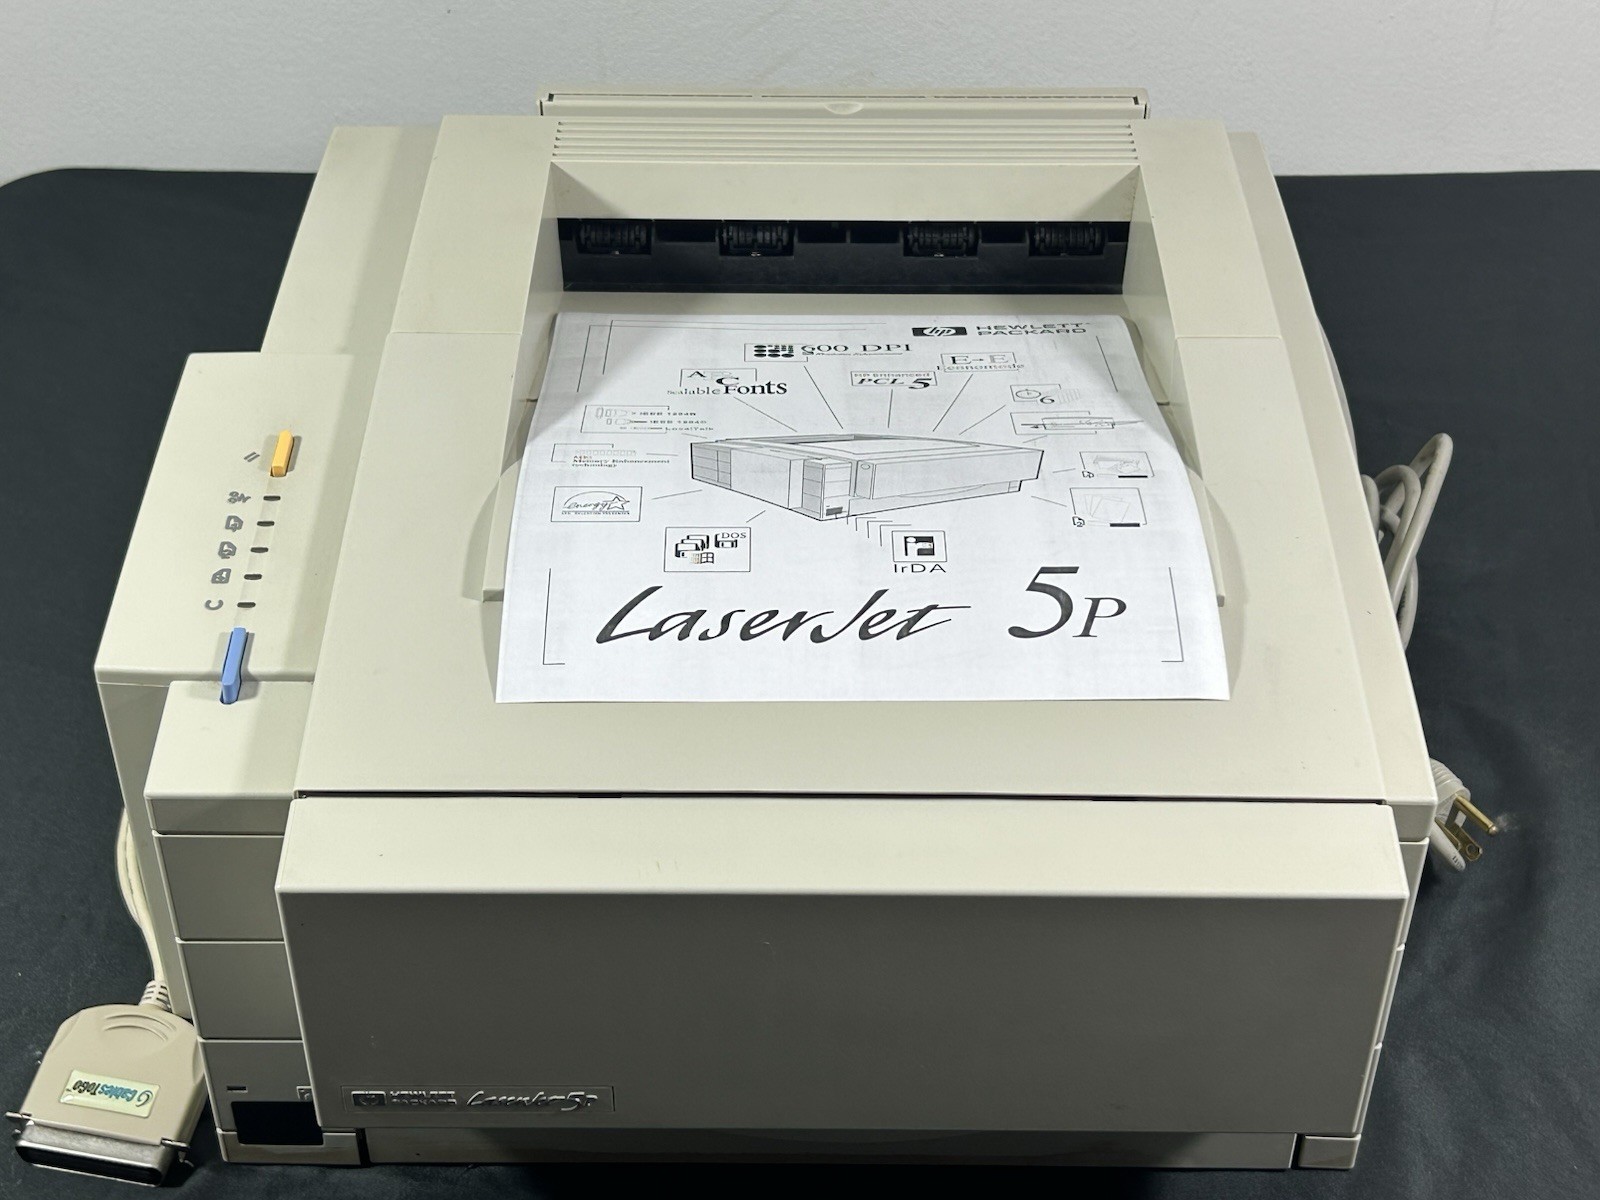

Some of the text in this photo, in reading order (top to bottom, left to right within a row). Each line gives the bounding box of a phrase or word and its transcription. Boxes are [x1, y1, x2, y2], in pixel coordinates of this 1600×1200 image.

[976, 322, 1083, 331] HEWLETT
[978, 328, 1087, 336] PACKARD
[862, 343, 912, 352] DPI
[724, 380, 787, 395] Fonts
[908, 377, 932, 389] 5
[1040, 396, 1055, 405] 6
[721, 531, 747, 539] DOS
[894, 563, 946, 573] IrDA
[596, 585, 971, 644] LaserJet
